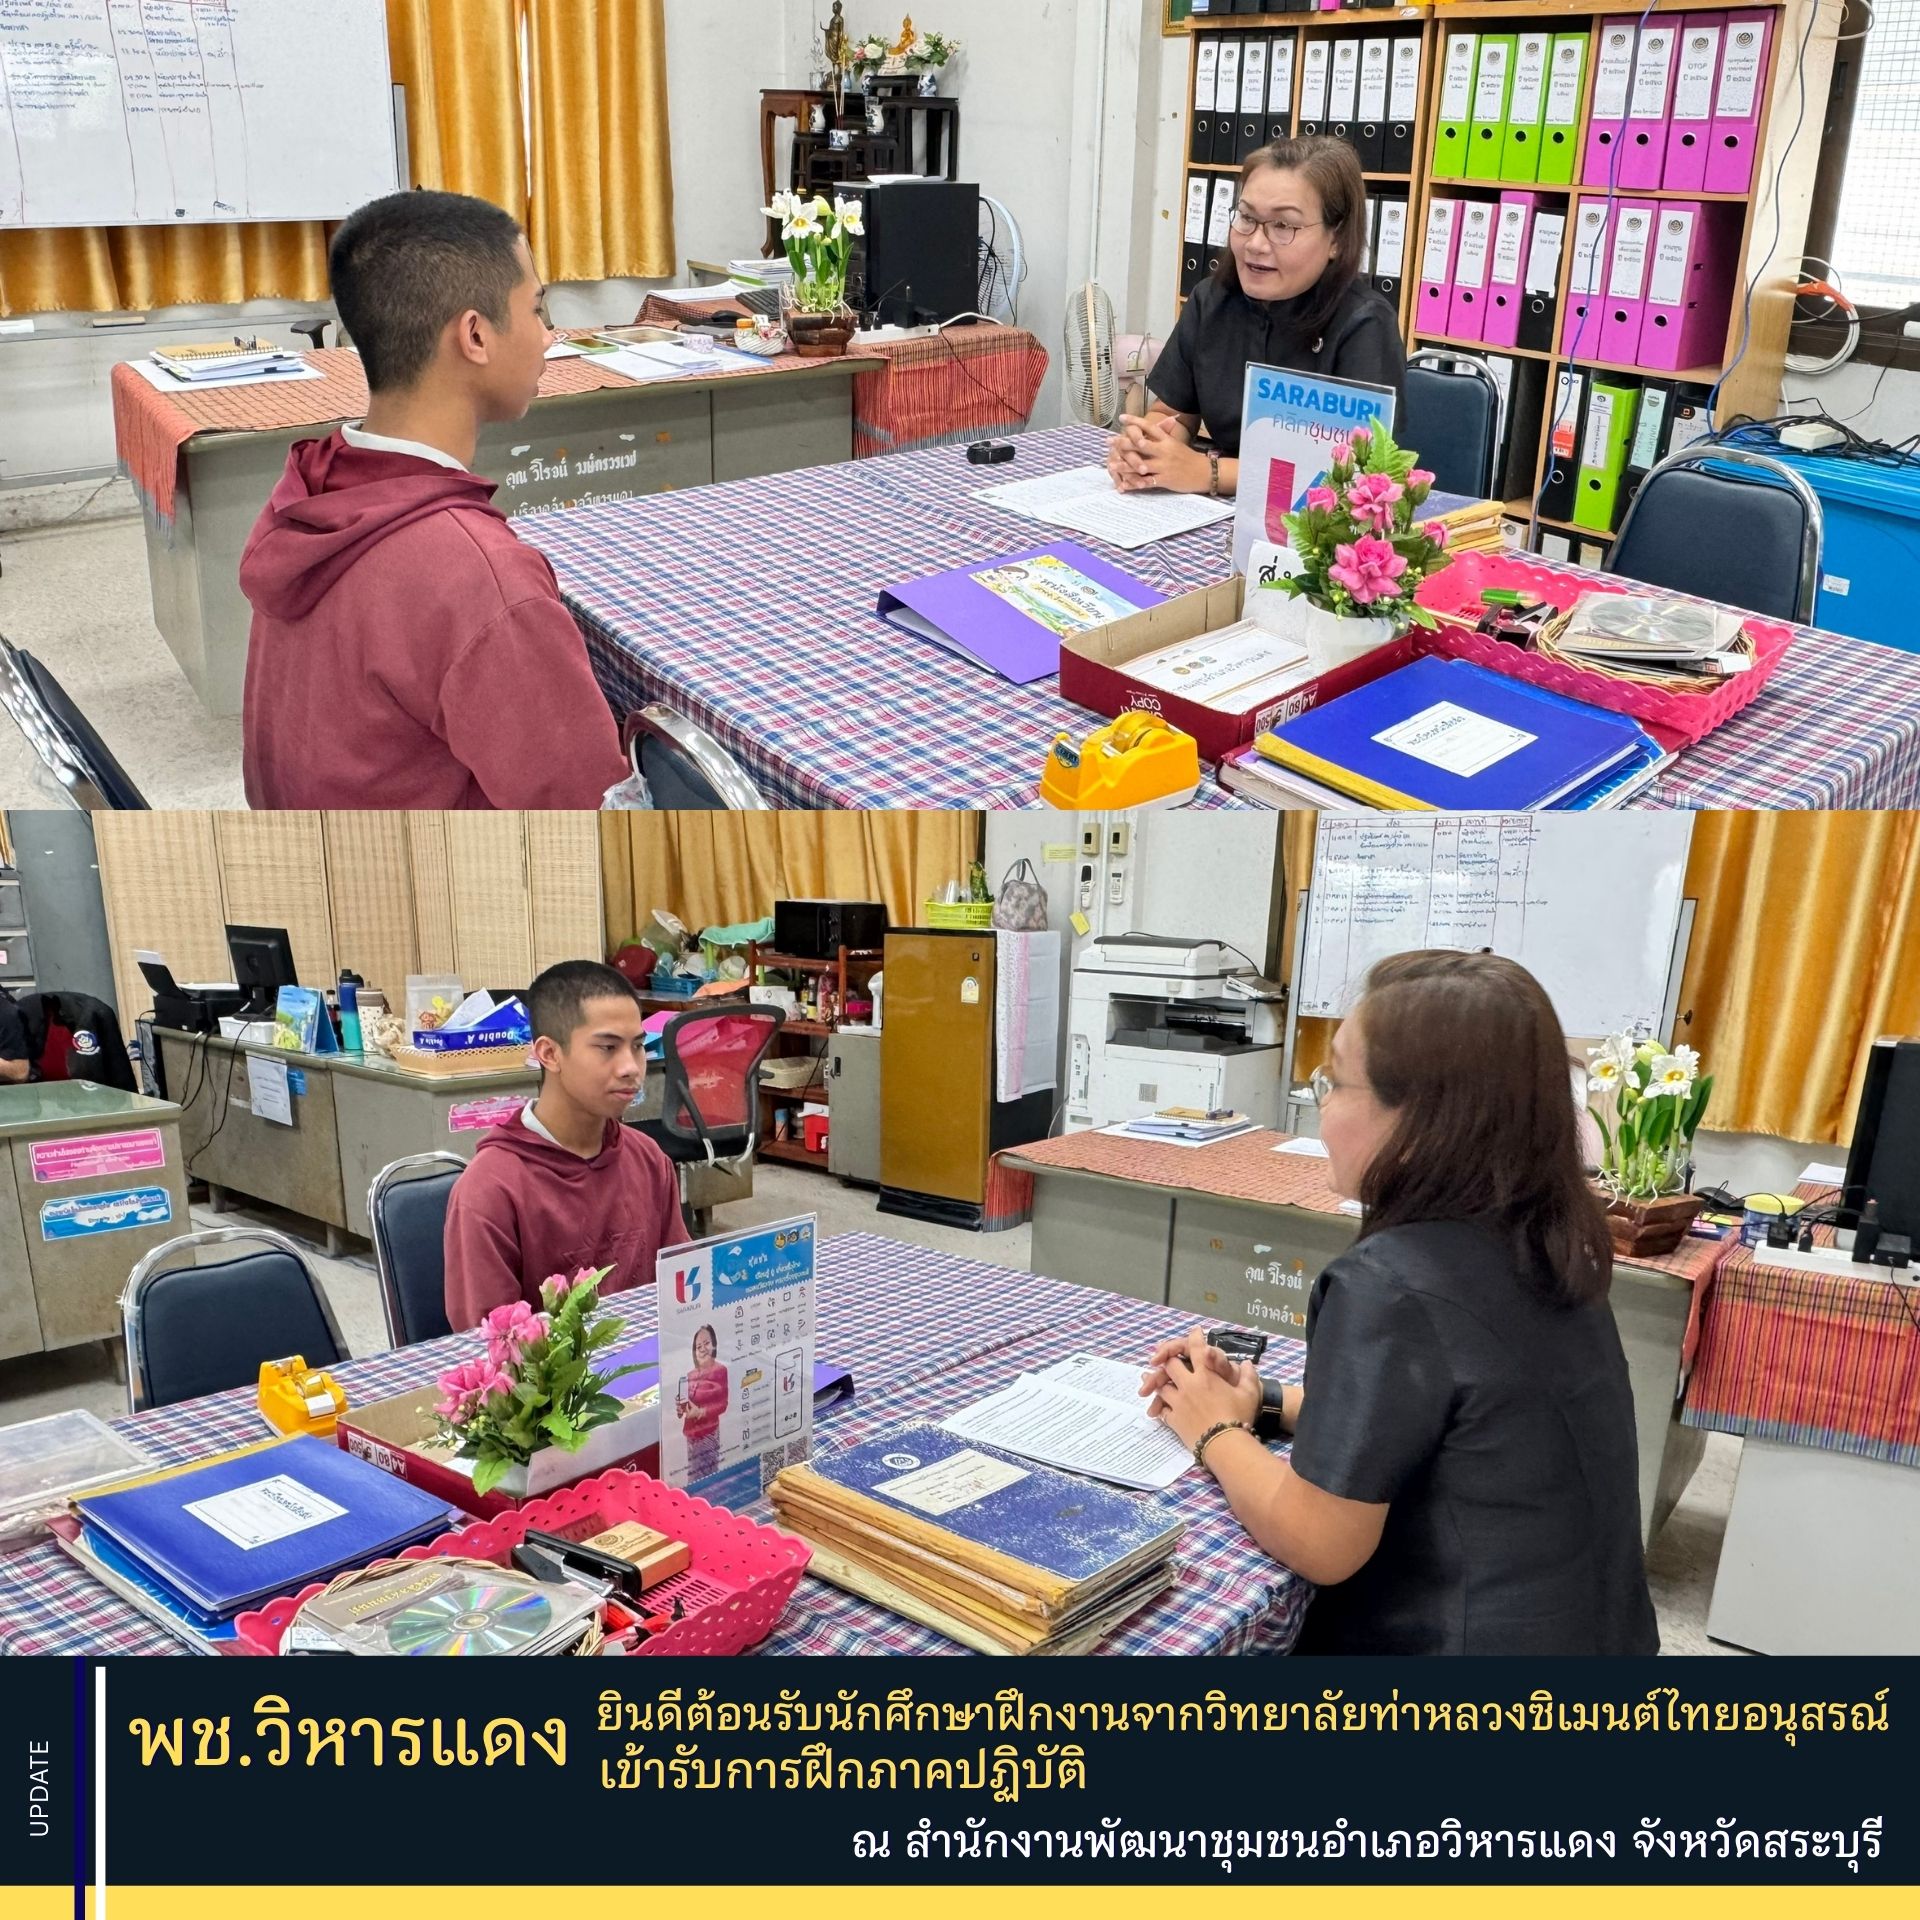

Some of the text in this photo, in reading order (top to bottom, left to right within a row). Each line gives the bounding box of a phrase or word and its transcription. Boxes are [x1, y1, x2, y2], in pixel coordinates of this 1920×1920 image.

[1257, 377, 1382, 422] SARABURI
[505, 471, 528, 491] คุณ
[529, 457, 568, 482] วิโรจน์
[1130, 695, 1162, 711] COPY
[1288, 699, 1301, 717] 80
[1255, 714, 1271, 732] 500
[467, 1029, 514, 1044] Double A
[1245, 1261, 1303, 1290] คุณ วิโรจน์
[378, 1451, 390, 1467] 80
[390, 1457, 406, 1475] A4
